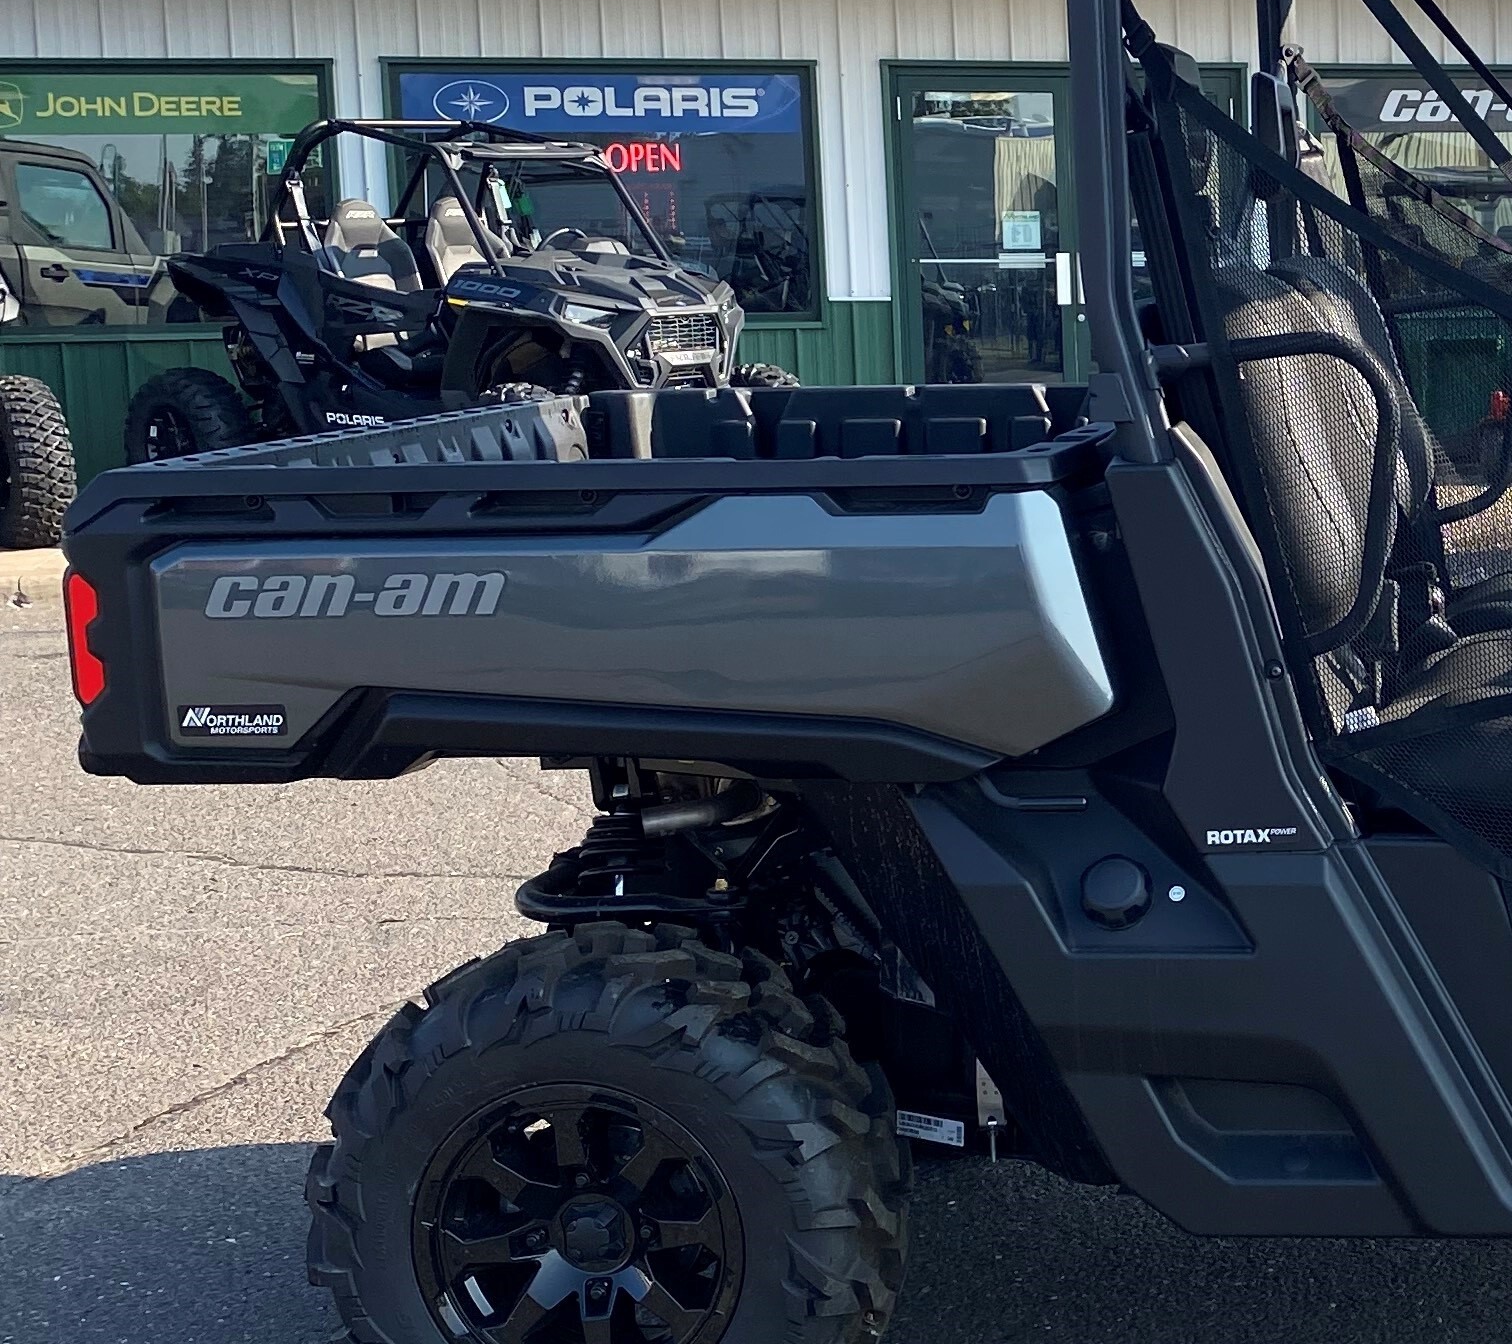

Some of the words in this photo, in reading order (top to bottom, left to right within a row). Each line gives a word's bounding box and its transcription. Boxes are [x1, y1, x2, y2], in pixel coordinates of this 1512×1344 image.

[36, 92, 127, 117] JOHN
[132, 92, 242, 117] DEERE
[523, 86, 759, 117] POLARIS
[605, 142, 682, 174] OPEN
[453, 279, 521, 298] 1000
[326, 412, 385, 427] POLARIS
[205, 572, 505, 618] can-am
[210, 726, 278, 735] MOTORSPORTS
[1207, 829, 1271, 845] ROTAX
[1270, 827, 1297, 835] POWER
